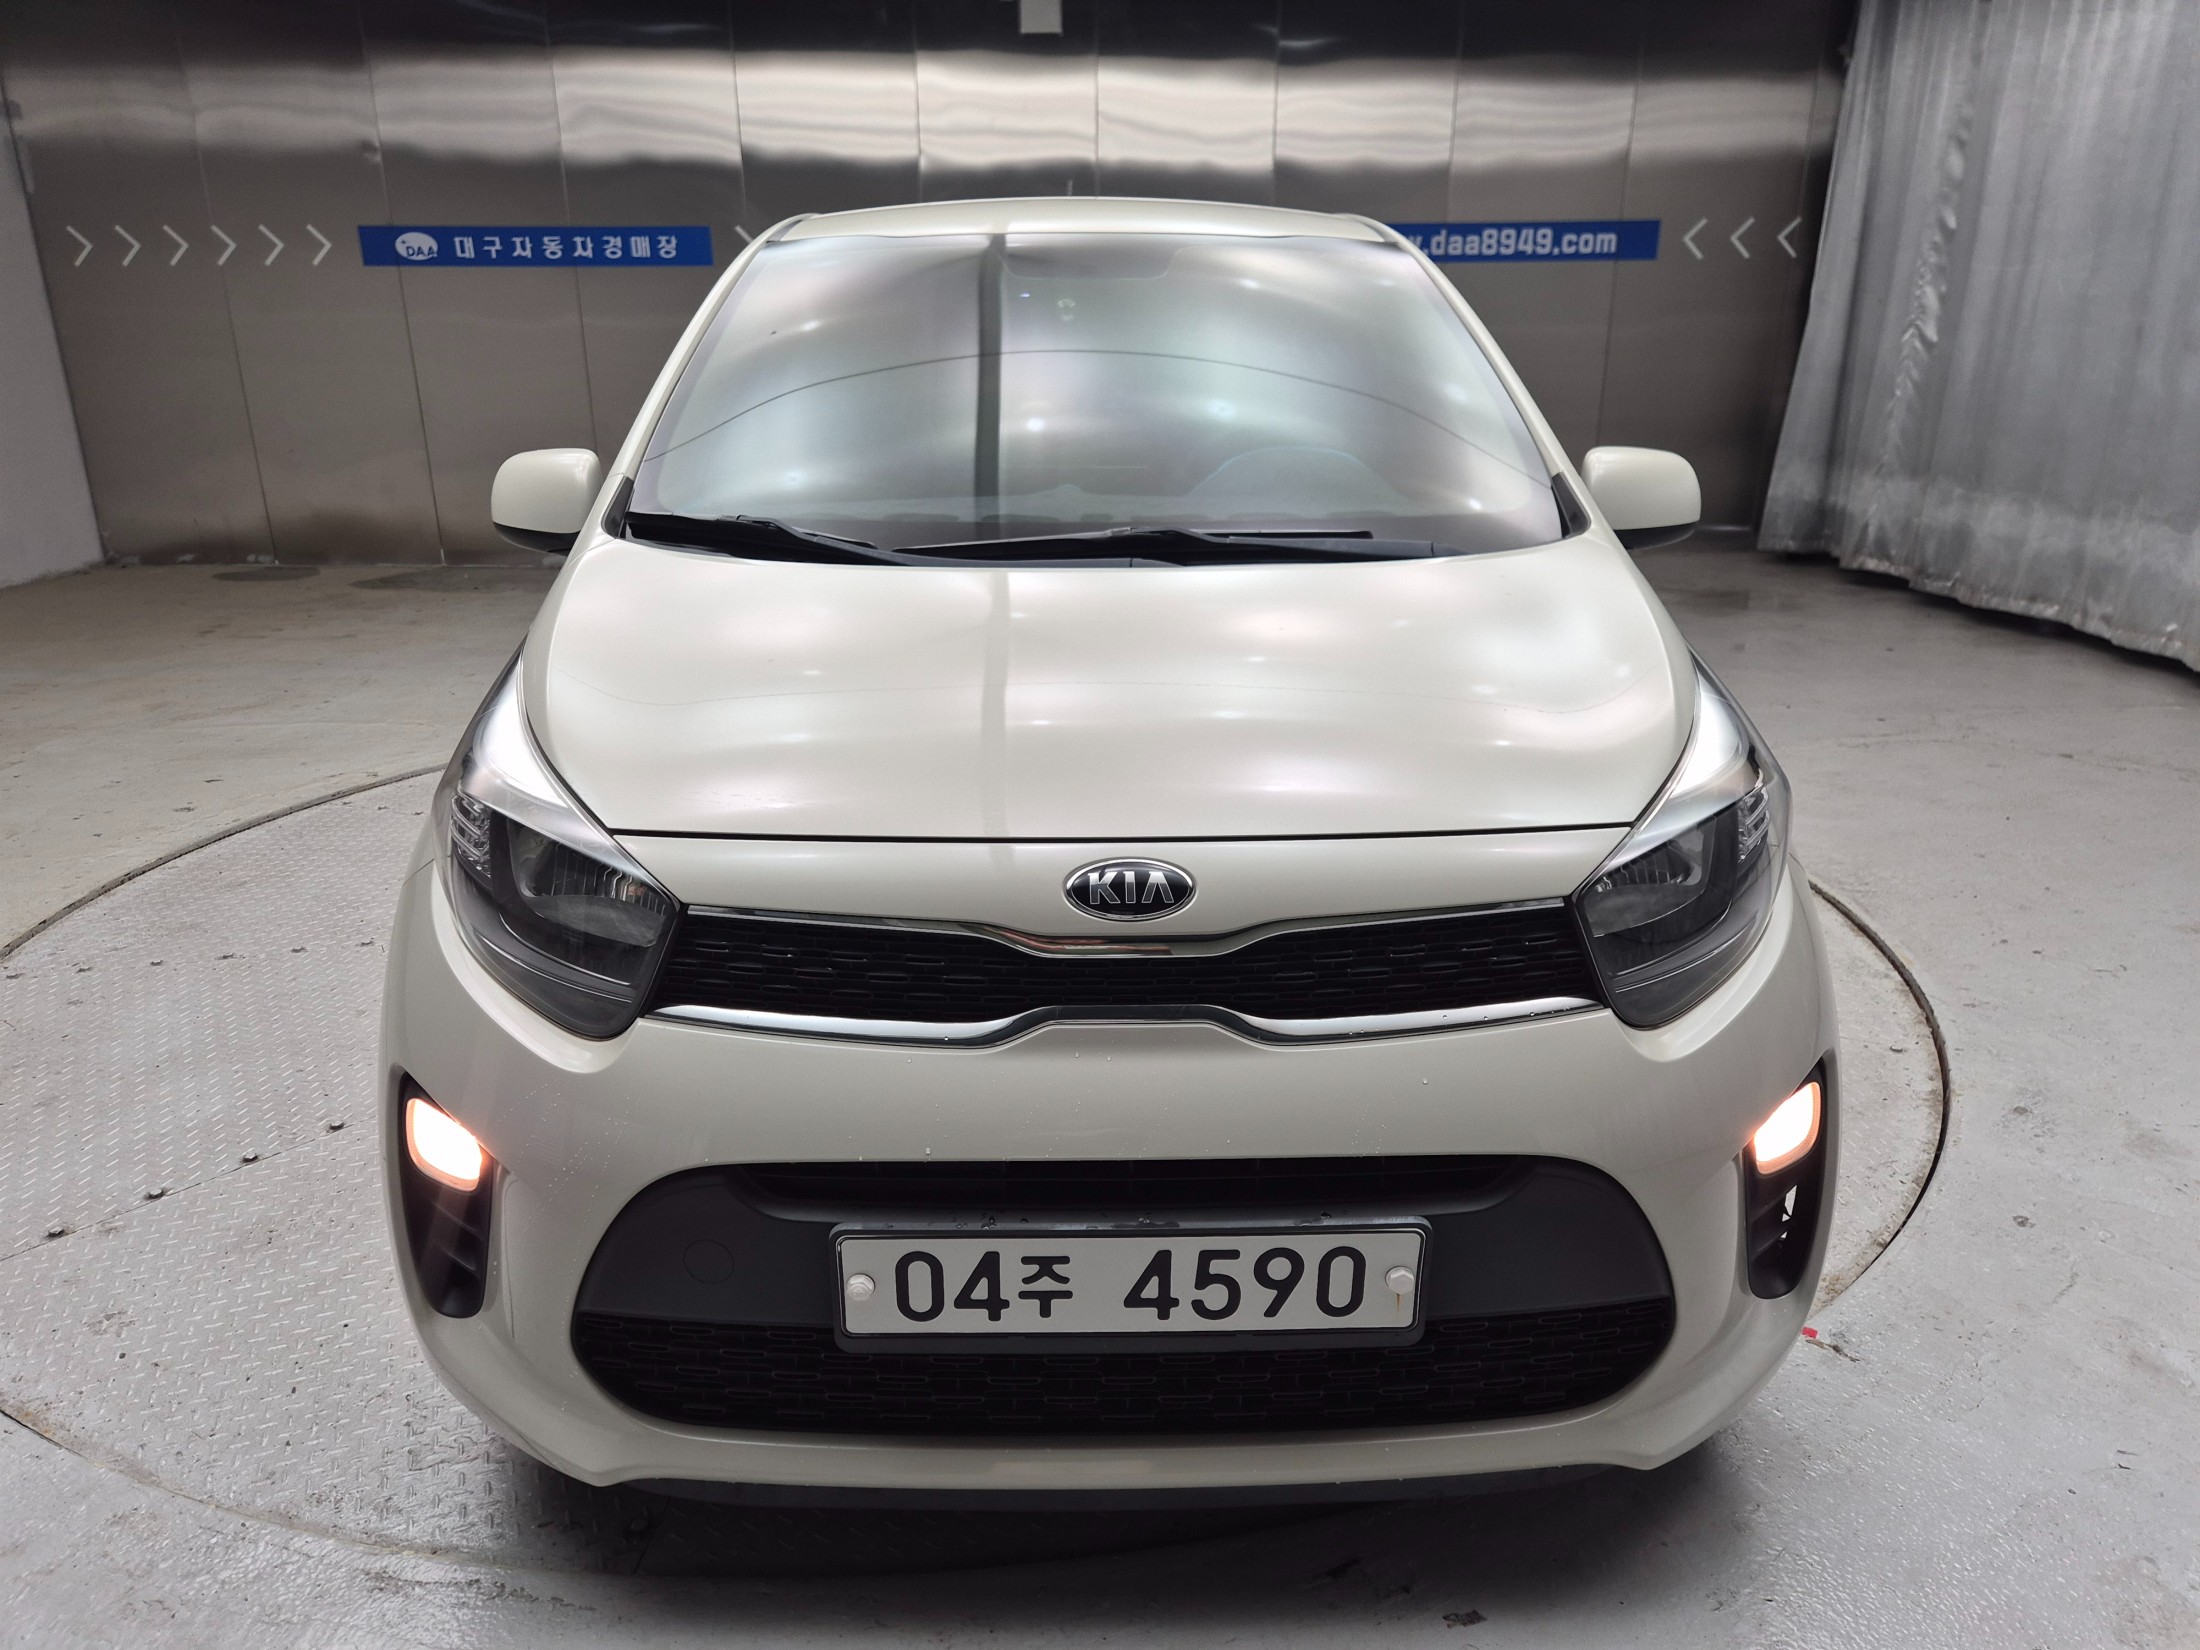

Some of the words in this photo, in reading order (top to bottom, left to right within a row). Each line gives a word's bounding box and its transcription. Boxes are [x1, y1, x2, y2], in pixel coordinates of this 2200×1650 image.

[406, 243, 439, 258] DAA
[1087, 870, 1175, 905] KIA
[894, 1250, 1074, 1322] 04주
[1123, 1245, 1367, 1320] 4590
